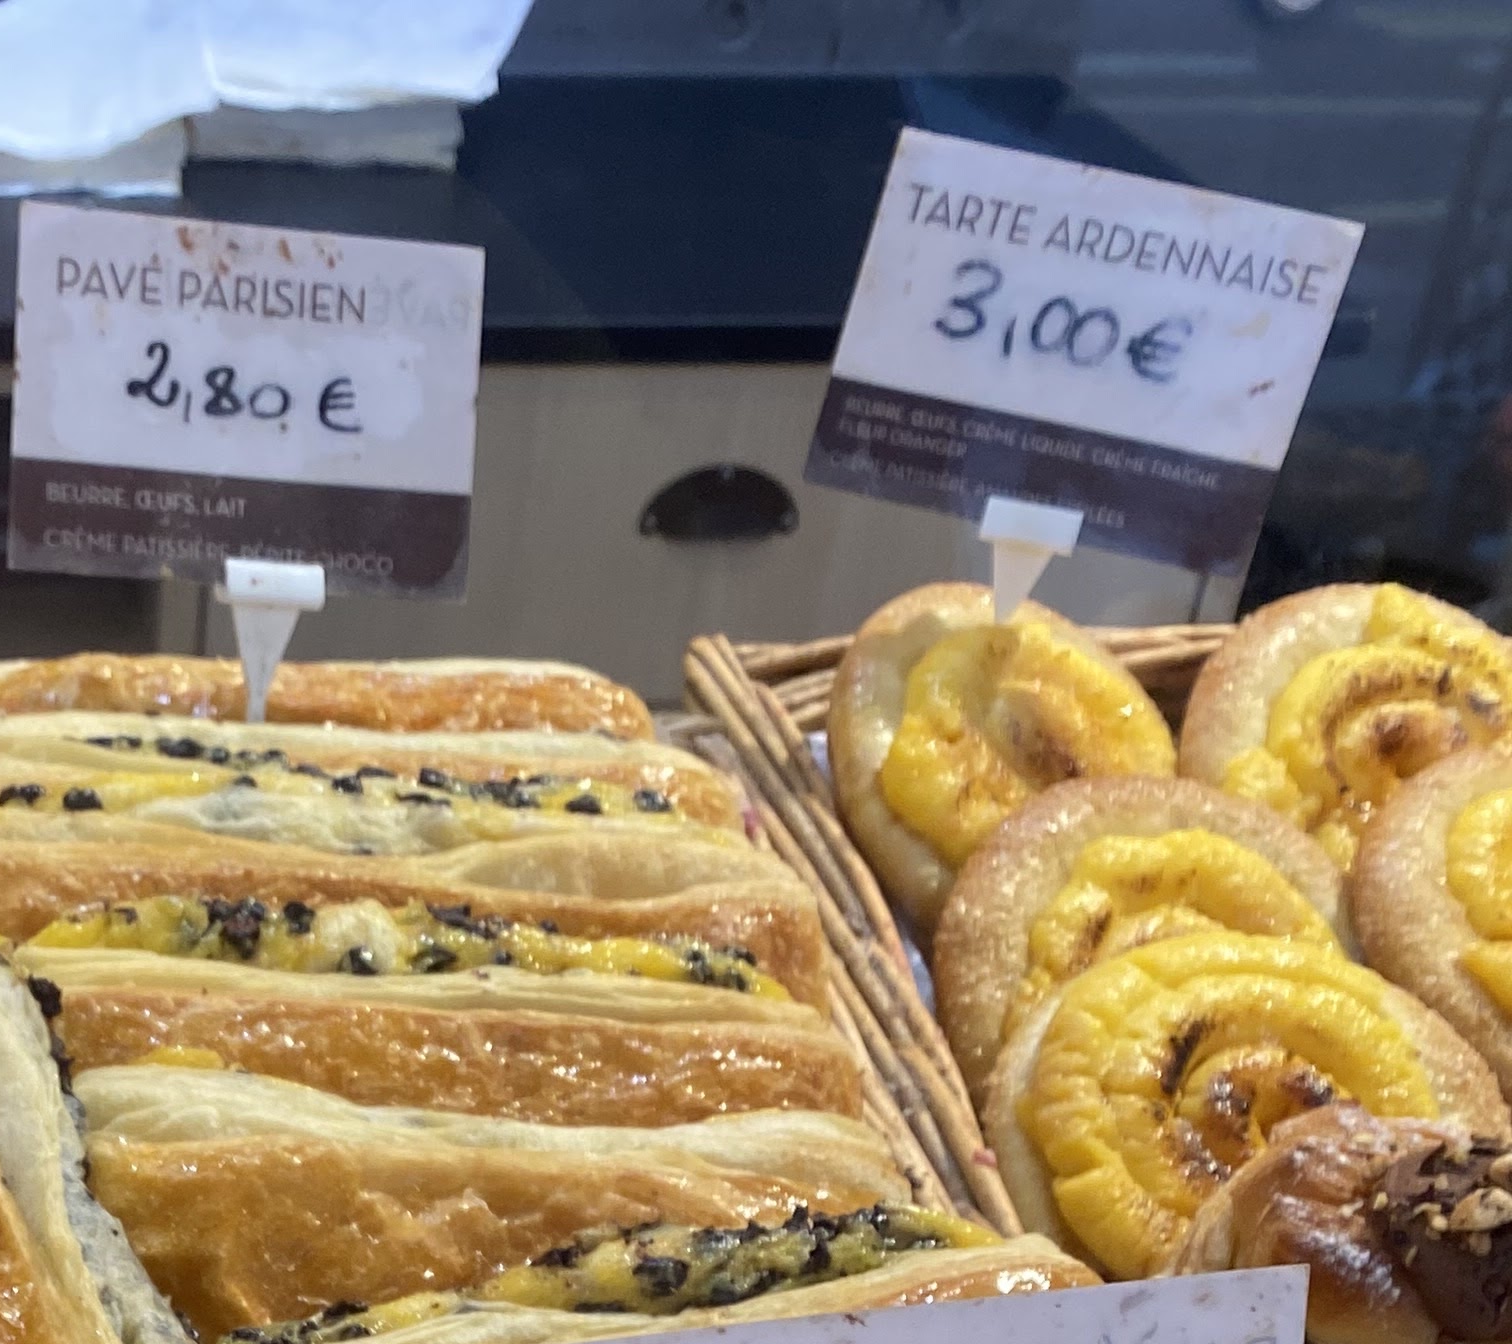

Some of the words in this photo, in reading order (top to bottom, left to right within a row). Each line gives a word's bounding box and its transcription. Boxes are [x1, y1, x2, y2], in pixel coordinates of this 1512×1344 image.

[909, 182, 1038, 246] TARTE
[1041, 215, 1327, 305] ARDENNAISE
[178, 268, 367, 324] PARISIEN
[204, 496, 245, 519] LAIT
